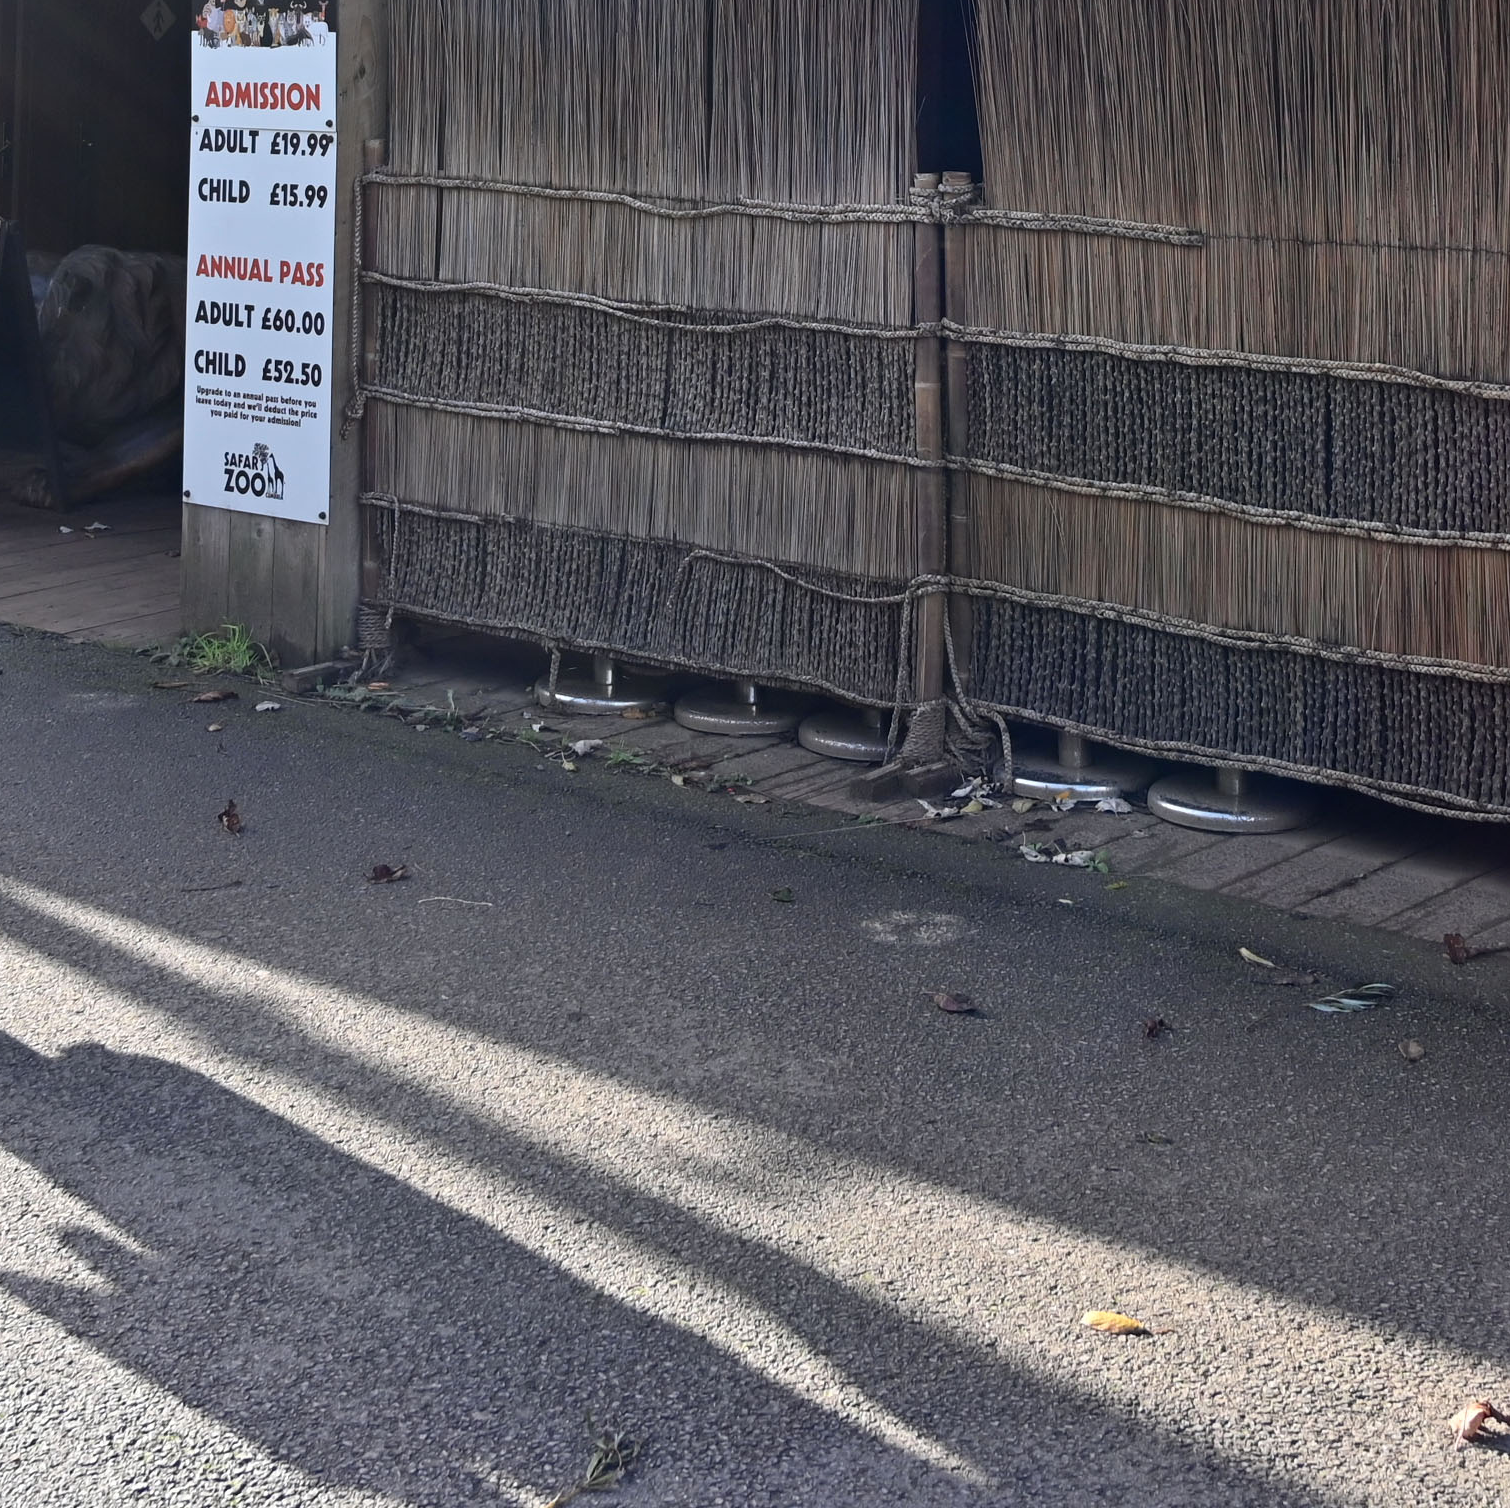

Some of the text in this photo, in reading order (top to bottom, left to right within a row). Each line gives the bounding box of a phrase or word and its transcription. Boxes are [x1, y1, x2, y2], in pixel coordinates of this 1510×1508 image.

[205, 81, 320, 110] ADMISSION
[199, 129, 330, 156] ADULT £19.99
[198, 178, 327, 208] CHILD £15.99
[196, 254, 324, 287] ANNUAL PASS
[195, 300, 324, 335] ADULT £60.00
[195, 350, 322, 387] CHILD £52.50
[196, 396, 211, 405] leave
[214, 398, 231, 408] today
[247, 403, 262, 411] we'll
[264, 404, 286, 414] deduct
[289, 408, 299, 416] the
[301, 410, 317, 419] price
[197, 385, 223, 396] Upgrade
[243, 393, 263, 401] annual
[266, 396, 278, 404] pass
[281, 396, 302, 406] before
[304, 400, 316, 408] you
[224, 410, 238, 419] paid
[240, 412, 249, 420] for
[268, 416, 301, 427] admission!
[224, 468, 266, 497] ZOO
